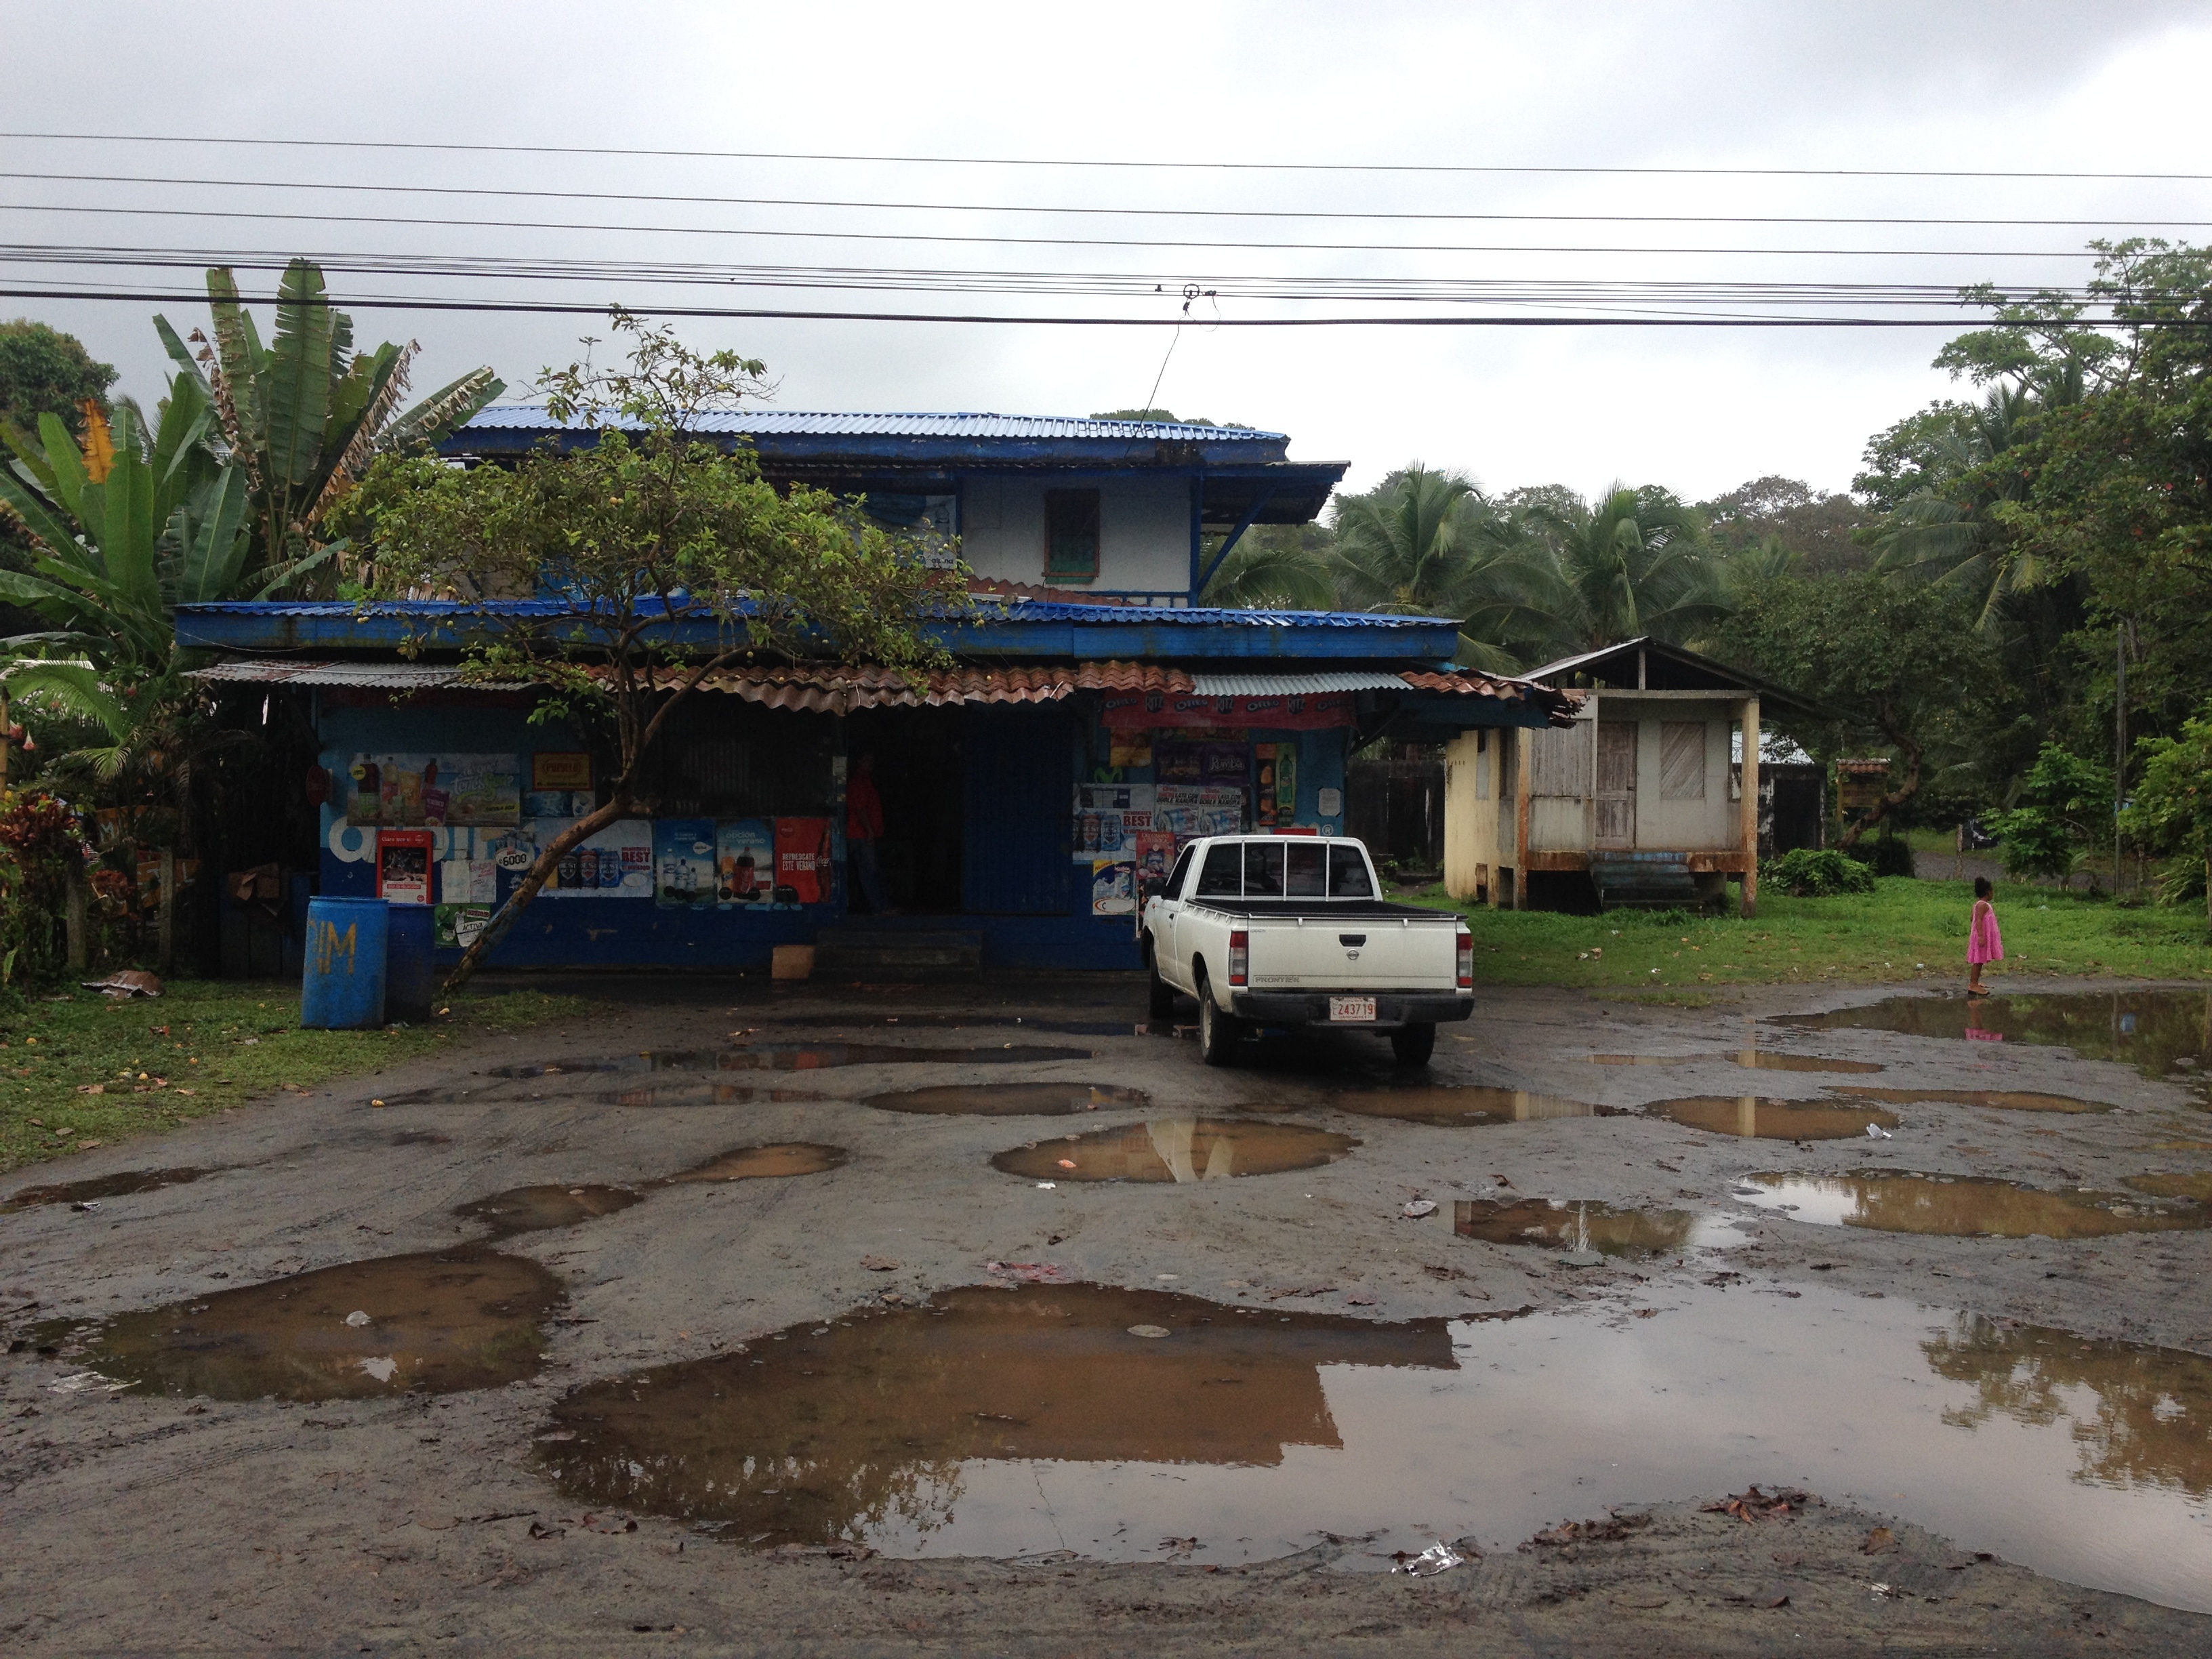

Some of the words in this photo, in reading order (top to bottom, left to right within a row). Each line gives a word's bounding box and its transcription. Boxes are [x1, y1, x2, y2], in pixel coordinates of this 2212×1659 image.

[1209, 755, 1244, 771] Rumba
[1124, 815, 1151, 827] BEST
[621, 851, 651, 863] BEST
[782, 861, 794, 871] ESTE
[796, 861, 815, 871] VERANO
[1338, 1003, 1373, 1015] 243719
